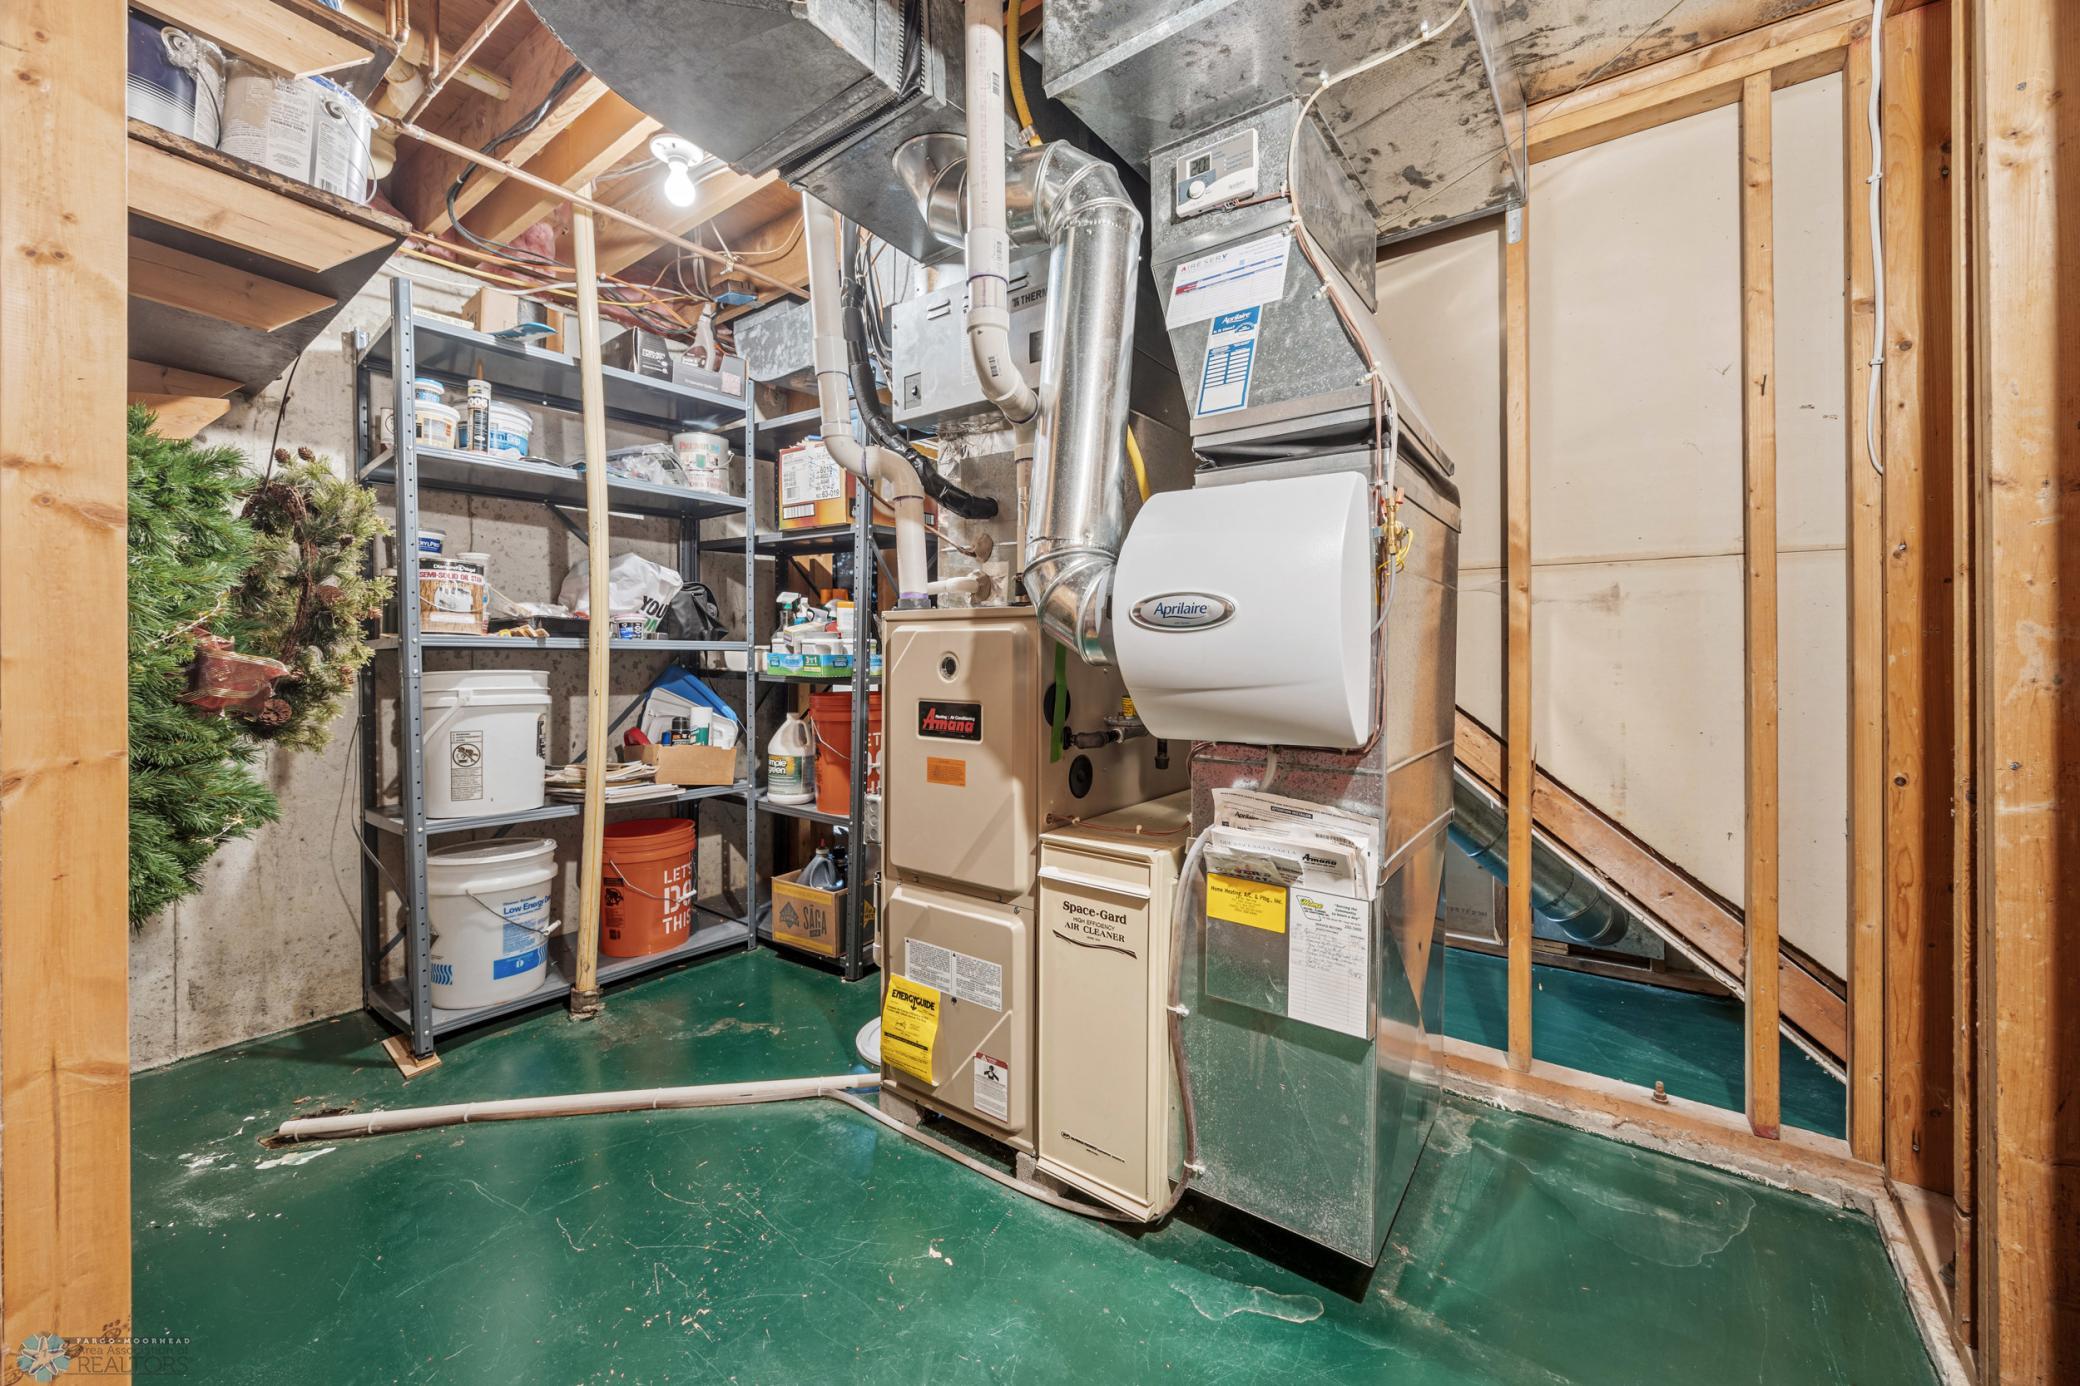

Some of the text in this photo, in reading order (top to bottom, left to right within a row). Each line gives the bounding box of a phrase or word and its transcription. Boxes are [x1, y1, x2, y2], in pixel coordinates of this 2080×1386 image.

[1154, 602, 1208, 619] Aprilaire
[922, 707, 975, 733] Amana
[768, 759, 787, 768] imple
[1302, 854, 1337, 866] Amana
[503, 906, 522, 915] Low
[522, 899, 544, 911] Energy
[1065, 922, 1080, 932] AIR
[1083, 925, 1125, 942] CLEANER
